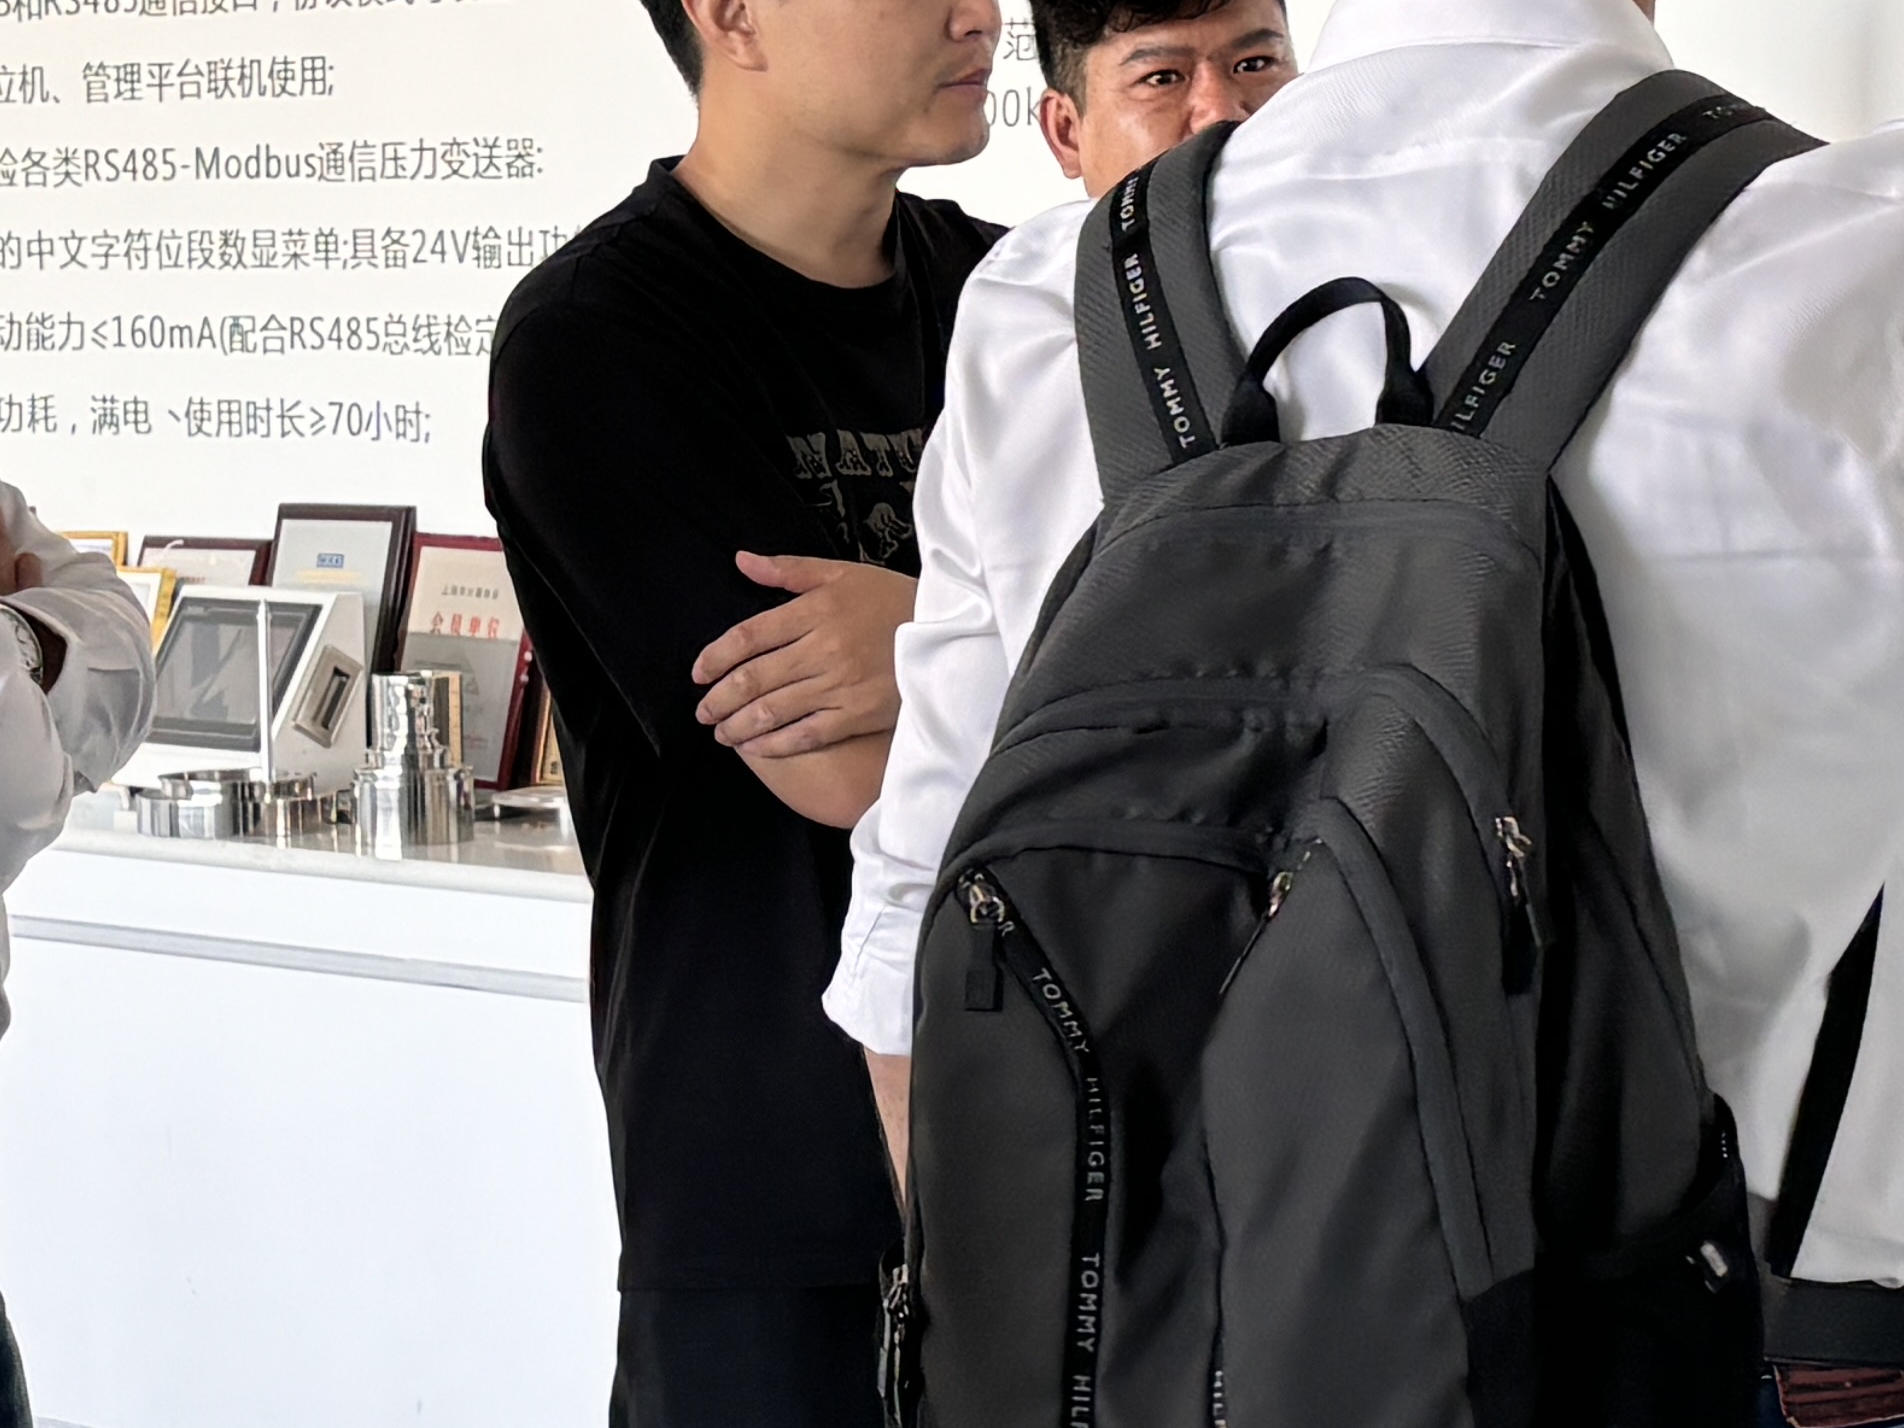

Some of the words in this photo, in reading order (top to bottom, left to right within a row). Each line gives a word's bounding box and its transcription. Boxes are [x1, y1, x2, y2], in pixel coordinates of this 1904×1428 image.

[1124, 253, 1163, 352] HILFIGER
[1449, 340, 1517, 432] ILFIGER
[1528, 220, 1596, 302] TOMMY
[1154, 367, 1196, 450] TOMMY
[1032, 967, 1091, 1054] TOMMY
[1084, 1077, 1106, 1202] HILFIGER
[1076, 1252, 1101, 1353] TOMMY
